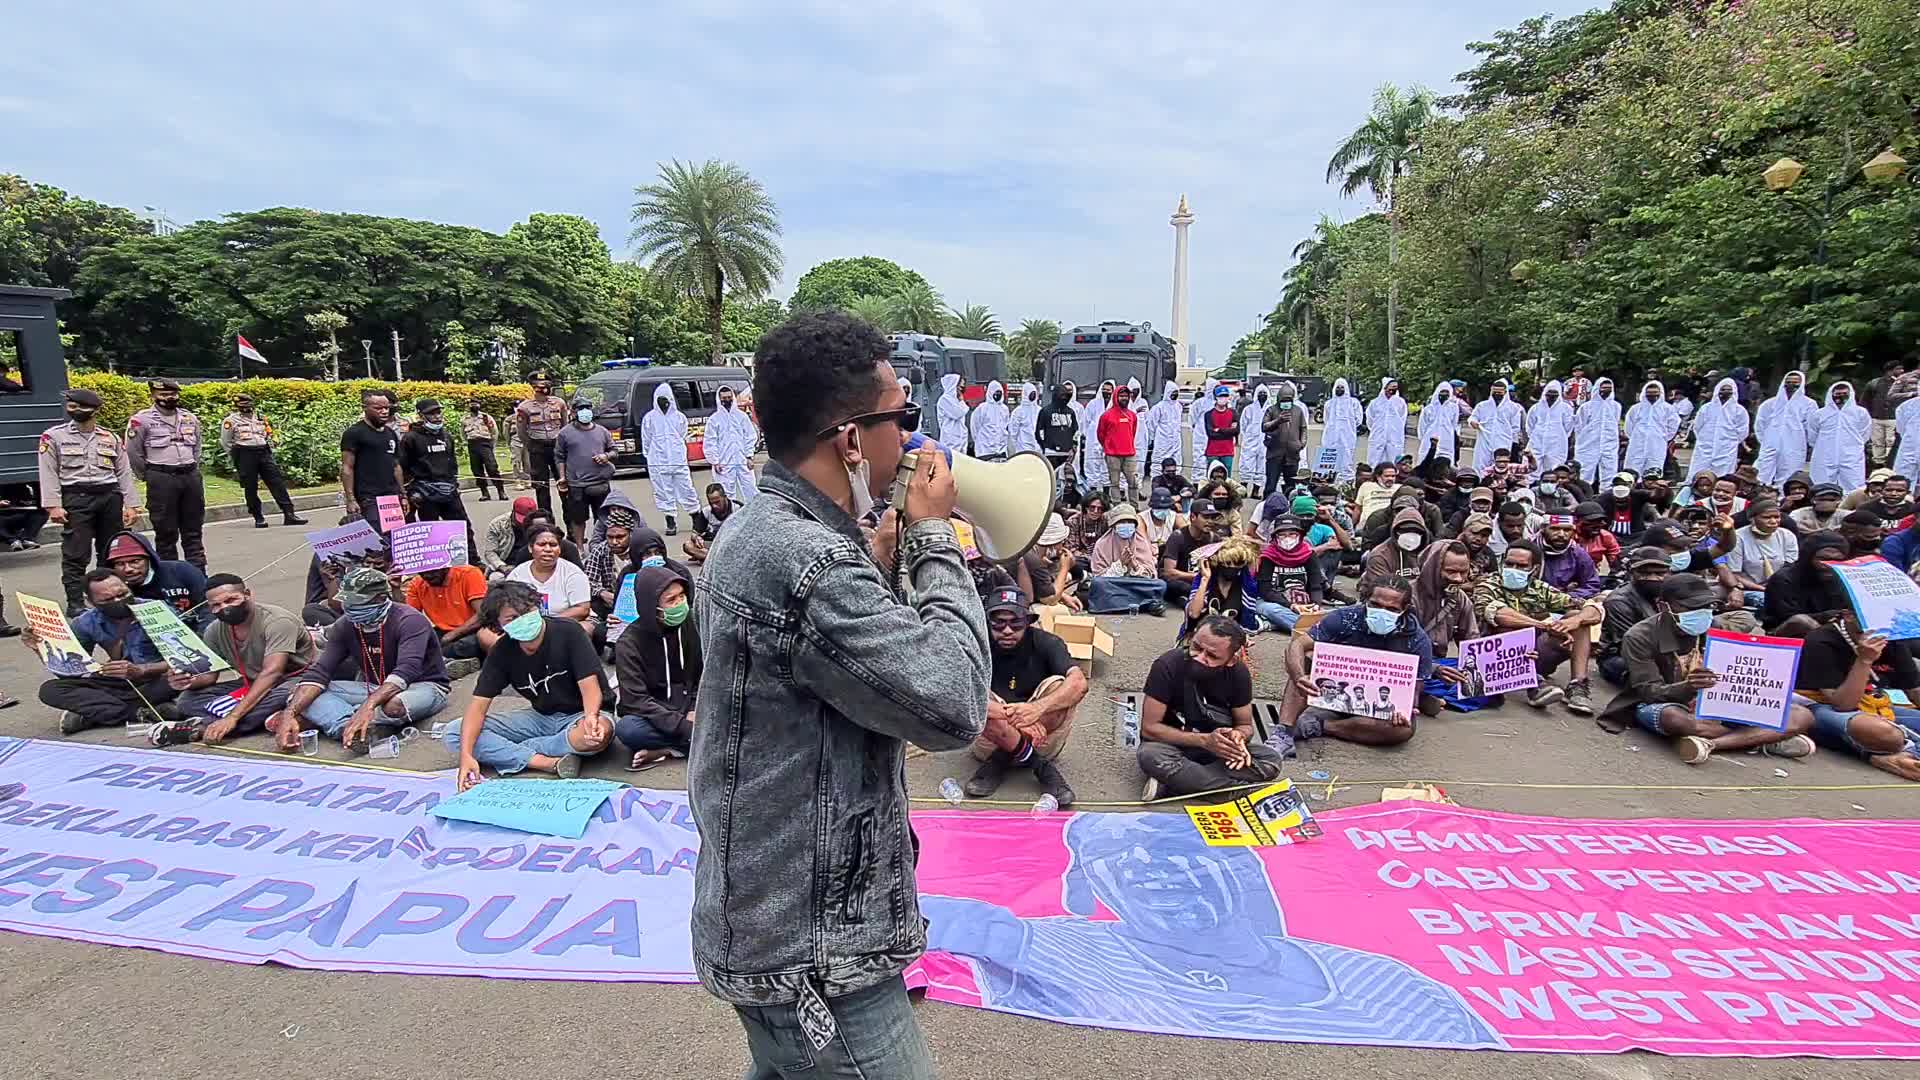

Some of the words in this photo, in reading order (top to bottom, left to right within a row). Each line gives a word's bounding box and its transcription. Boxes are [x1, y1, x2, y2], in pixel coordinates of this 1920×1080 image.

[394, 525, 432, 540] FREEPORT
[394, 542, 417, 552] SUFFER
[394, 544, 453, 558] ENVIRONMENTAL
[394, 555, 424, 565] DAMAGE
[405, 561, 421, 570] WEST
[422, 558, 445, 568] PAPUA
[26, 611, 65, 626] HAPPINESS
[47, 607, 60, 617] NO
[1467, 638, 1503, 656] STOP
[1496, 644, 1527, 661] SLOW
[1317, 653, 1336, 661] WEST
[1336, 655, 1359, 664] PAPUA
[1360, 659, 1387, 668] WOMEN
[1485, 655, 1531, 674] MOTION
[1735, 655, 1764, 667] USUT
[1315, 661, 1348, 670] CHILDREN
[1349, 665, 1368, 673] ONLY
[1389, 671, 1413, 680] KILLED
[1328, 670, 1384, 683] INDONESIA'S
[1387, 678, 1413, 687] ARMY
[1485, 665, 1531, 682] GENOCIDE
[1726, 664, 1769, 678] PELAKU
[1494, 682, 1512, 691] WEST
[1512, 678, 1536, 688] PAPUA
[1717, 674, 1784, 690] ENEMBAKAN
[1729, 684, 1760, 696] ANAK
[1707, 691, 1717, 700] DI
[1720, 692, 1753, 705] INTAN
[1755, 698, 1781, 710] JAYA
[69, 763, 441, 815] PERINGATAN
[0, 800, 287, 850] DEKLARASI
[1194, 811, 1221, 840] PEPERA
[1208, 811, 1242, 840] 1969
[1344, 827, 1809, 856] DEMILITERISASI
[1377, 859, 1585, 891] CABUT
[180, 877, 641, 958] PAPUA
[1407, 902, 1723, 939] BERIKAN
[1713, 912, 1894, 941] HAK
[1437, 938, 1673, 979] NASIB
[1466, 981, 1702, 1024] WEST
